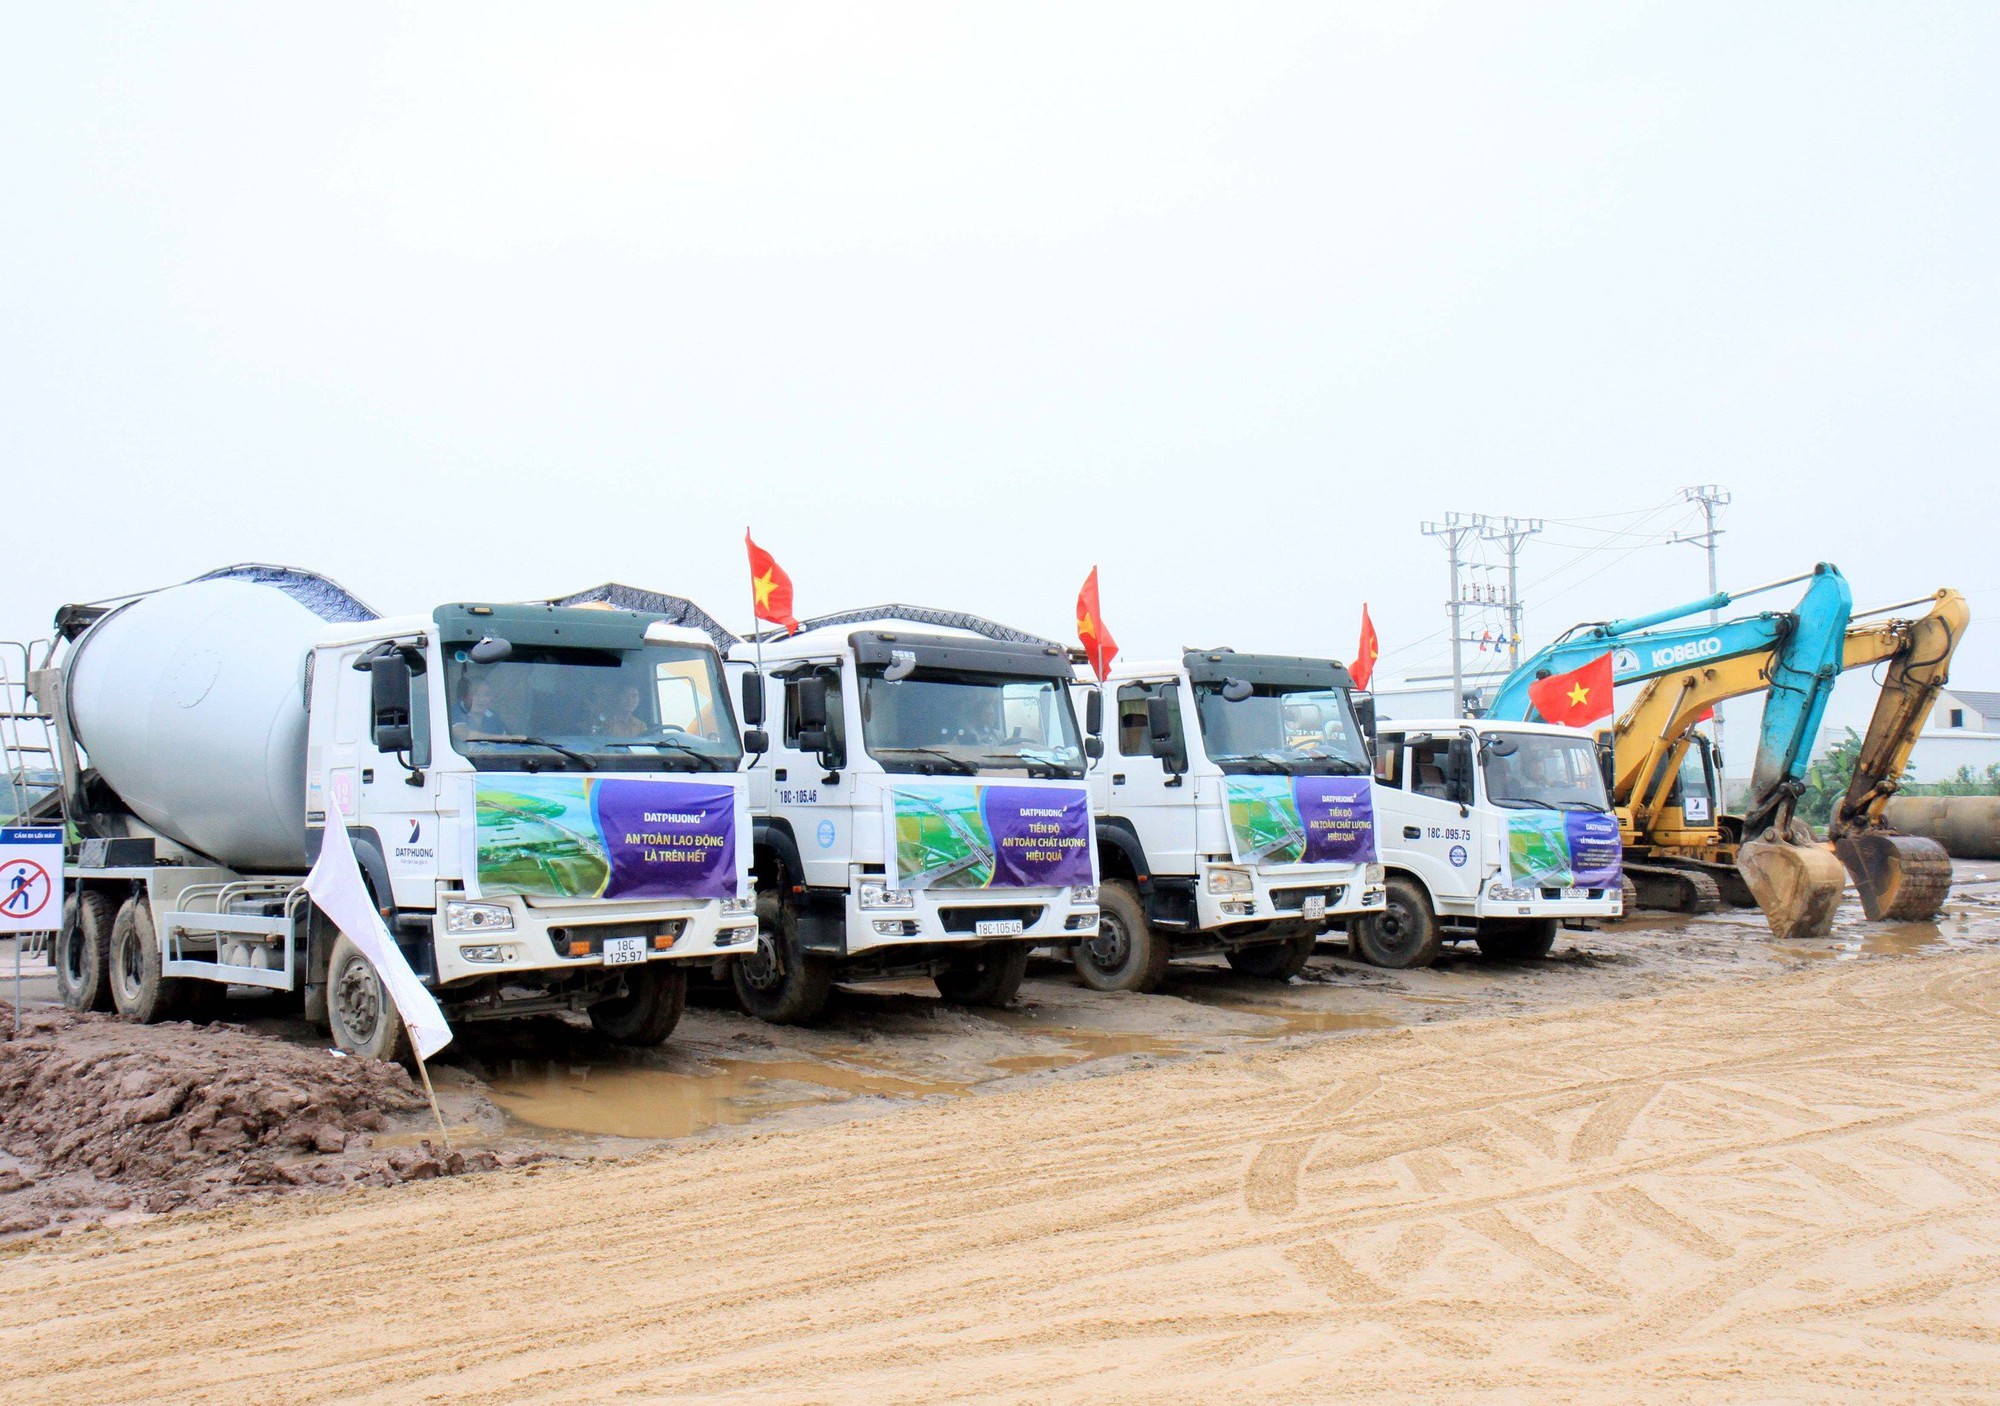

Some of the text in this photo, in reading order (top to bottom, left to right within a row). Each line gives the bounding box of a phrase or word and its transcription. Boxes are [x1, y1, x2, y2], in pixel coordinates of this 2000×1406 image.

[1651, 637, 1721, 667] KOBELCO
[644, 812, 700, 823] DATPHUONG
[1020, 808, 1063, 817] DATPHUONG
[1029, 822, 1060, 835] TIẾN ĐỘ
[625, 832, 724, 849] AN TOÀN LAO ĐỘNG
[1003, 836, 1086, 849] AN TOÀN CHẤT LƯỢNG
[395, 848, 434, 857] DATPHUONG
[644, 849, 707, 862] LÀ TRÊN HẾT
[1026, 850, 1063, 863] HIỆU QUẢ
[617, 940, 634, 951] 18C
[610, 951, 642, 963] 125.97
